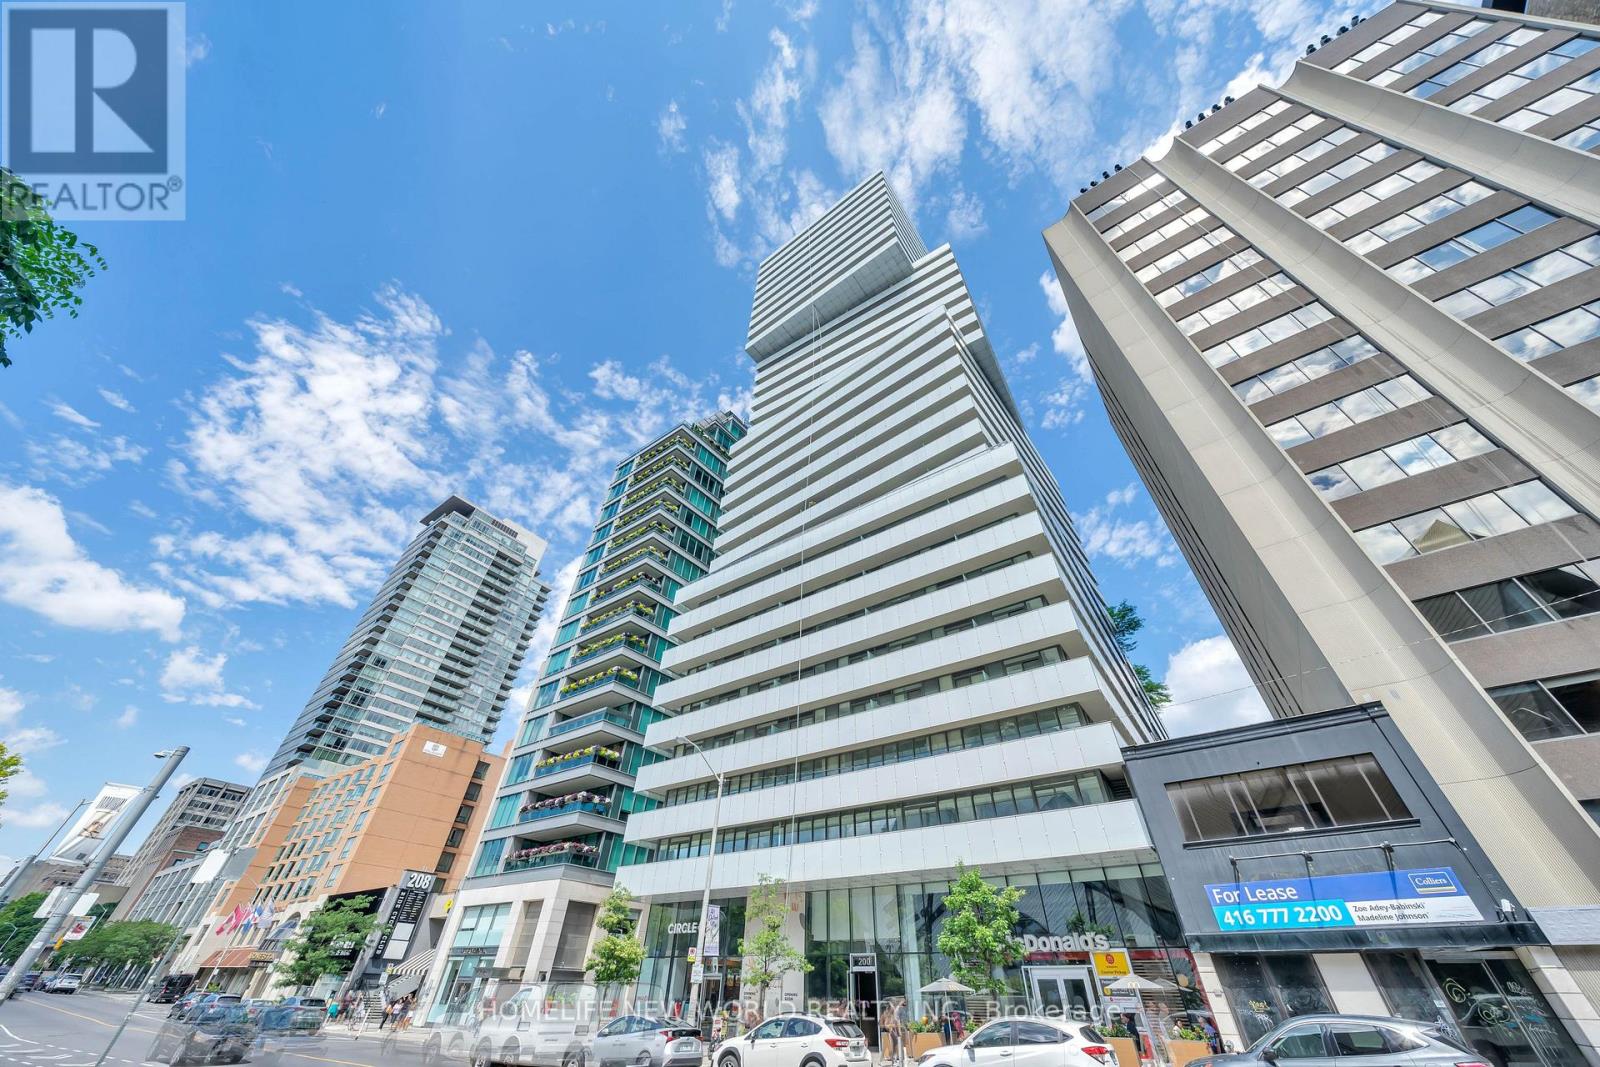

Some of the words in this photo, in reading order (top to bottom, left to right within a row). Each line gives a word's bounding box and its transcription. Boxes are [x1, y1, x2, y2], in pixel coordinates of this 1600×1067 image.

[406, 872, 432, 889] 208
[1415, 877, 1448, 886] Colliers
[1212, 888, 1240, 903] For
[1244, 886, 1298, 902] Lease
[1223, 909, 1255, 925] 416
[1256, 907, 1289, 924] 777
[1294, 905, 1343, 923] 2200
[1352, 905, 1368, 913] Zoe
[1357, 914, 1394, 922] Madeline
[1396, 912, 1429, 922] Johnson
[667, 922, 698, 934] CIRCLE
